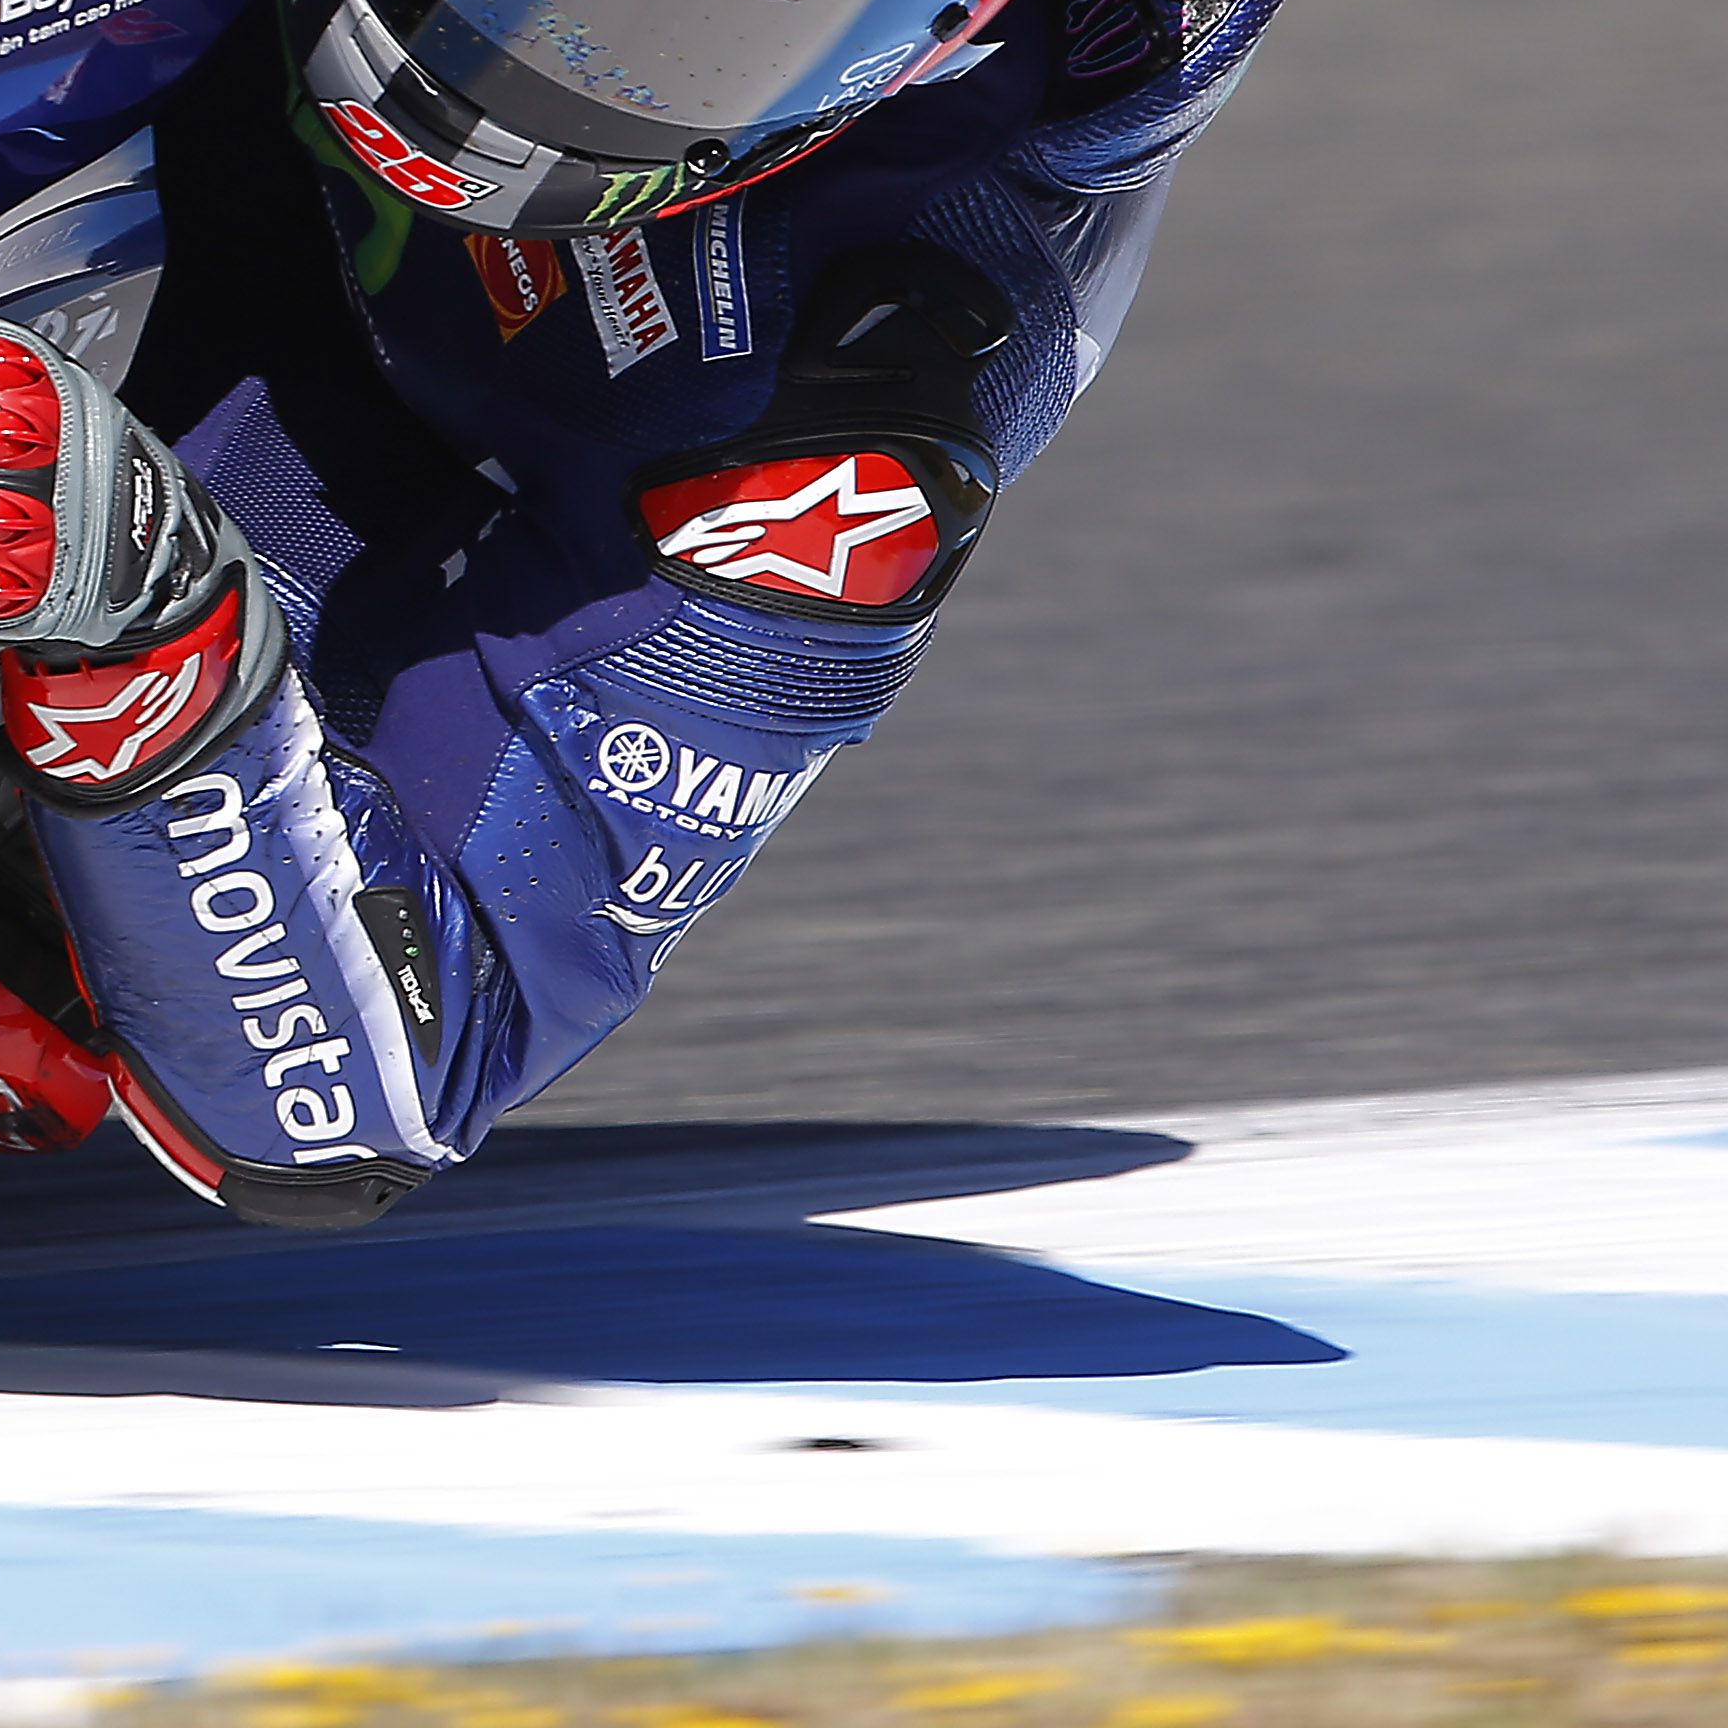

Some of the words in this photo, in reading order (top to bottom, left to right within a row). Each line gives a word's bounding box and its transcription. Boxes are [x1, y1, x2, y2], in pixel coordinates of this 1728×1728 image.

[318, 100, 506, 210] 25
[500, 237, 540, 313] NEOS
[602, 227, 668, 355] AMAHA
[709, 203, 738, 350] MICHELIN
[588, 777, 743, 841] FACTORY
[160, 772, 379, 1165] movistar
